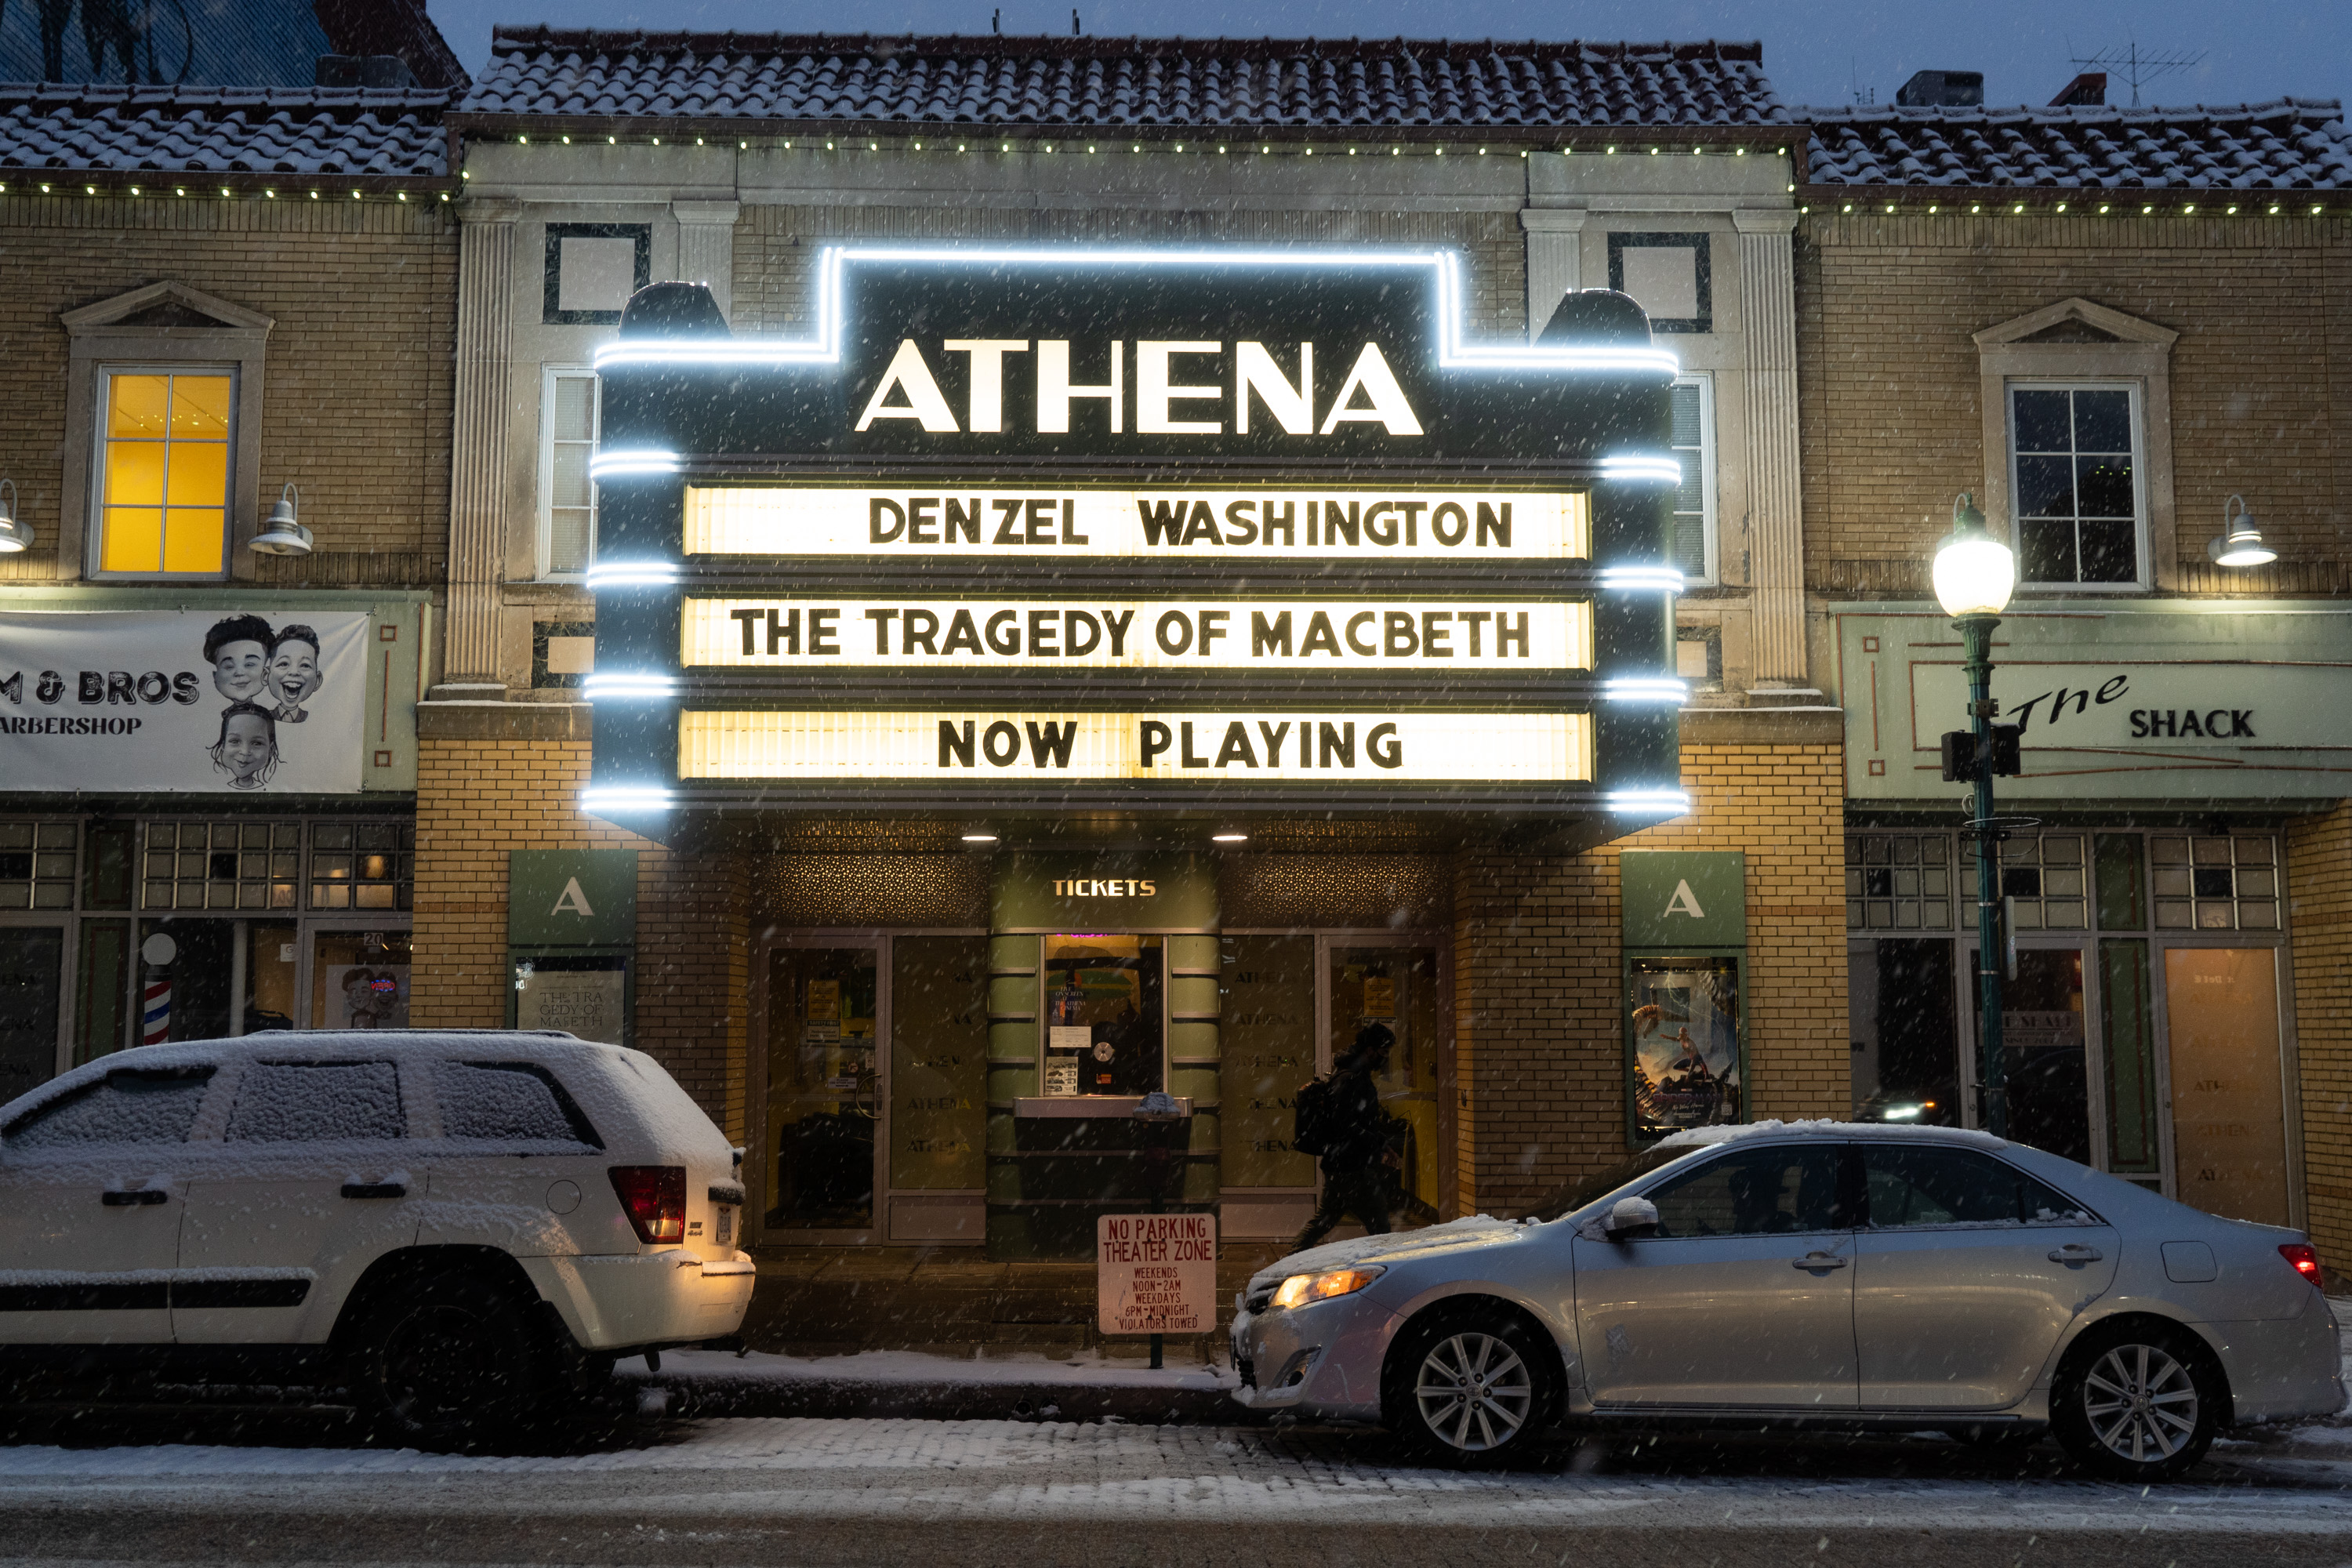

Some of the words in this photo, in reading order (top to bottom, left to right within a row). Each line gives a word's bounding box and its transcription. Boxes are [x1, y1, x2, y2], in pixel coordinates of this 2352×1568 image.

[855, 339, 1425, 437] ATHENA
[869, 497, 1089, 545] DENZEL
[1138, 499, 1512, 547] WASHINGTON
[730, 608, 840, 656] THE
[865, 608, 1135, 657] TRAGEDY
[1156, 610, 1229, 656] OF
[1252, 612, 1532, 658] MACBETH
[36, 670, 66, 704] &
[78, 671, 200, 705] BROS
[2006, 674, 2129, 736] The
[2129, 709, 2256, 739] SHACK
[938, 720, 1078, 769] NOW
[1139, 720, 1403, 770] PLAYING
[550, 876, 596, 916] A
[1052, 879, 1156, 898] TICKETS
[1662, 878, 1706, 919] A
[365, 933, 383, 946] 20
[906, 1097, 972, 1110] ATHENA
[1109, 1219, 1129, 1240] NO
[1136, 1218, 1206, 1240] PARKING
[1103, 1240, 1168, 1263] THEATER
[1174, 1240, 1212, 1261] ZONE
[1134, 1267, 1178, 1279] WEEKENDS
[1133, 1279, 1181, 1292] NOON-2AM
[1135, 1292, 1181, 1304] WEEKDAYS
[1125, 1305, 1189, 1317] 6PM-MIDNIGHT
[1119, 1318, 1166, 1330] VIOLATORS
[1170, 1317, 1197, 1329] TOWED
